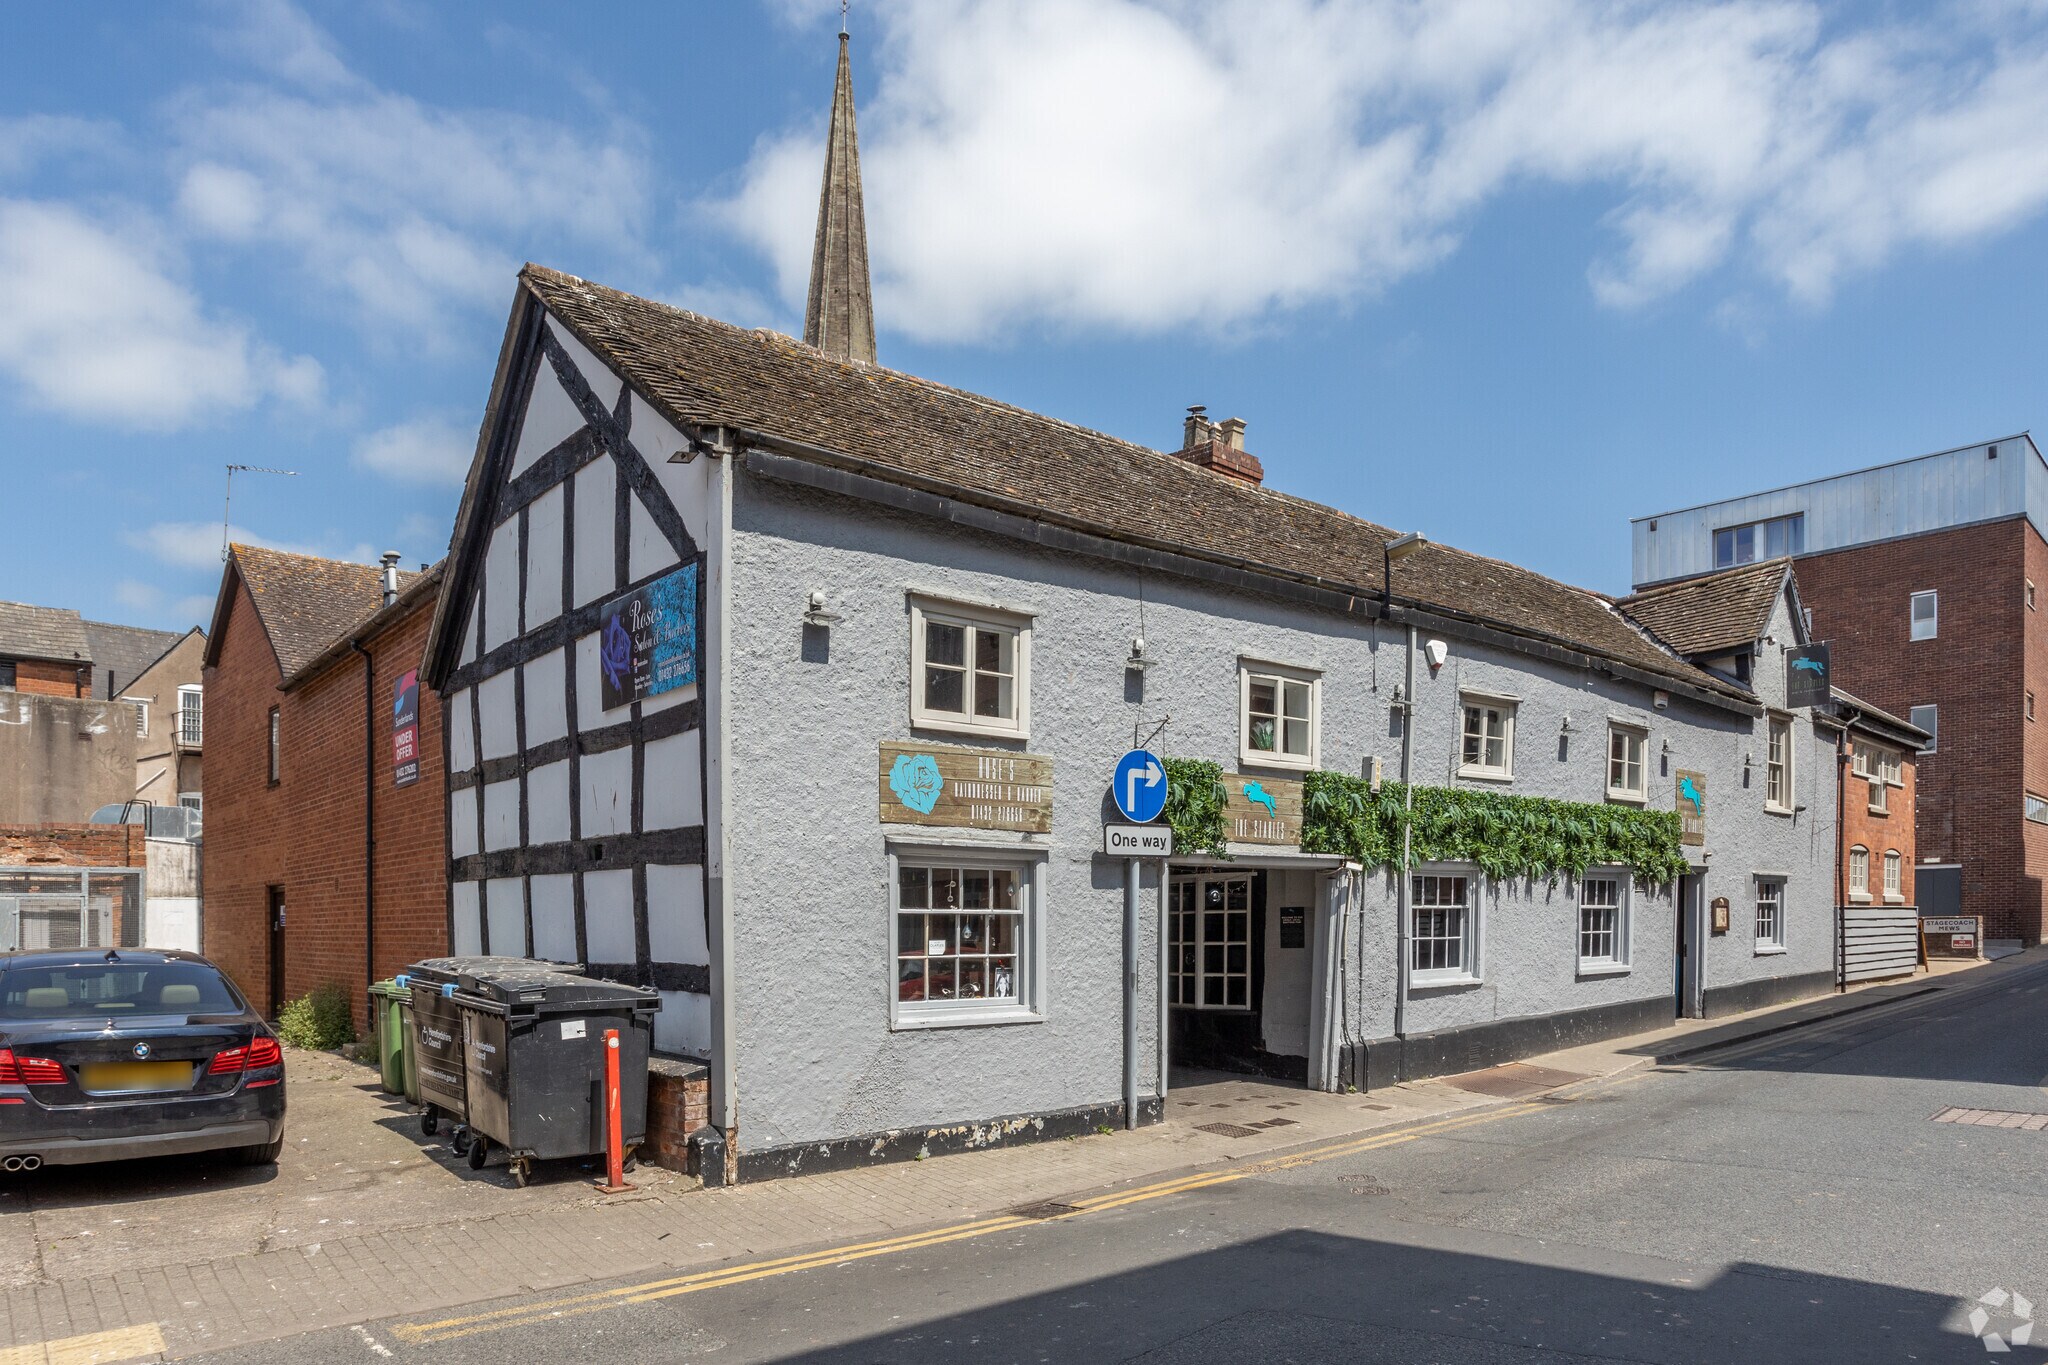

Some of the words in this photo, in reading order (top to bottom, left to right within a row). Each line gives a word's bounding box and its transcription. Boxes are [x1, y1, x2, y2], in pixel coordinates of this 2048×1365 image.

[629, 594, 663, 632] Rose's
[633, 630, 652, 653] Salon
[664, 616, 690, 641] Barbers
[395, 711, 414, 727] Sunderlands
[395, 730, 413, 748] UNDER
[396, 744, 413, 761] OFFER
[979, 756, 1014, 781] ROSE'S
[954, 782, 1002, 800] HAIRDRESSER
[1017, 786, 1041, 803] BARBER
[971, 804, 992, 821] 01432
[1235, 818, 1248, 838] THE
[1254, 820, 1285, 840] STABLES
[1111, 832, 1138, 847] One
[1142, 837, 1167, 851] way
[428, 1027, 452, 1042] Herefordshire
[428, 1037, 441, 1049] Council
